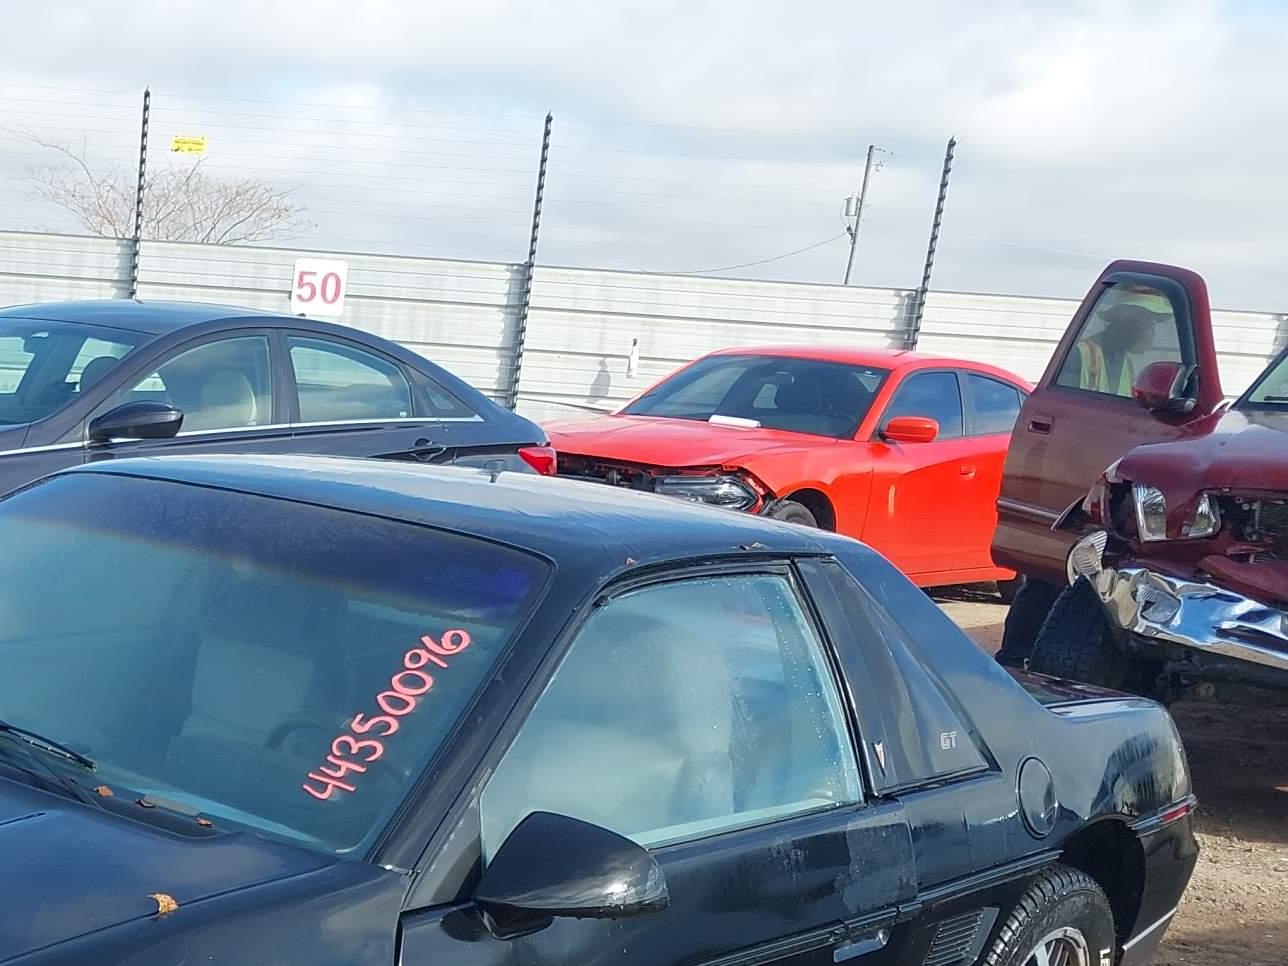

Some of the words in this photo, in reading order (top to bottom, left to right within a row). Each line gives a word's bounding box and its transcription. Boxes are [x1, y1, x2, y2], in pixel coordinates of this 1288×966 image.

[296, 271, 341, 304] 50
[302, 629, 471, 800] 44350096
[940, 731, 959, 750] GT
